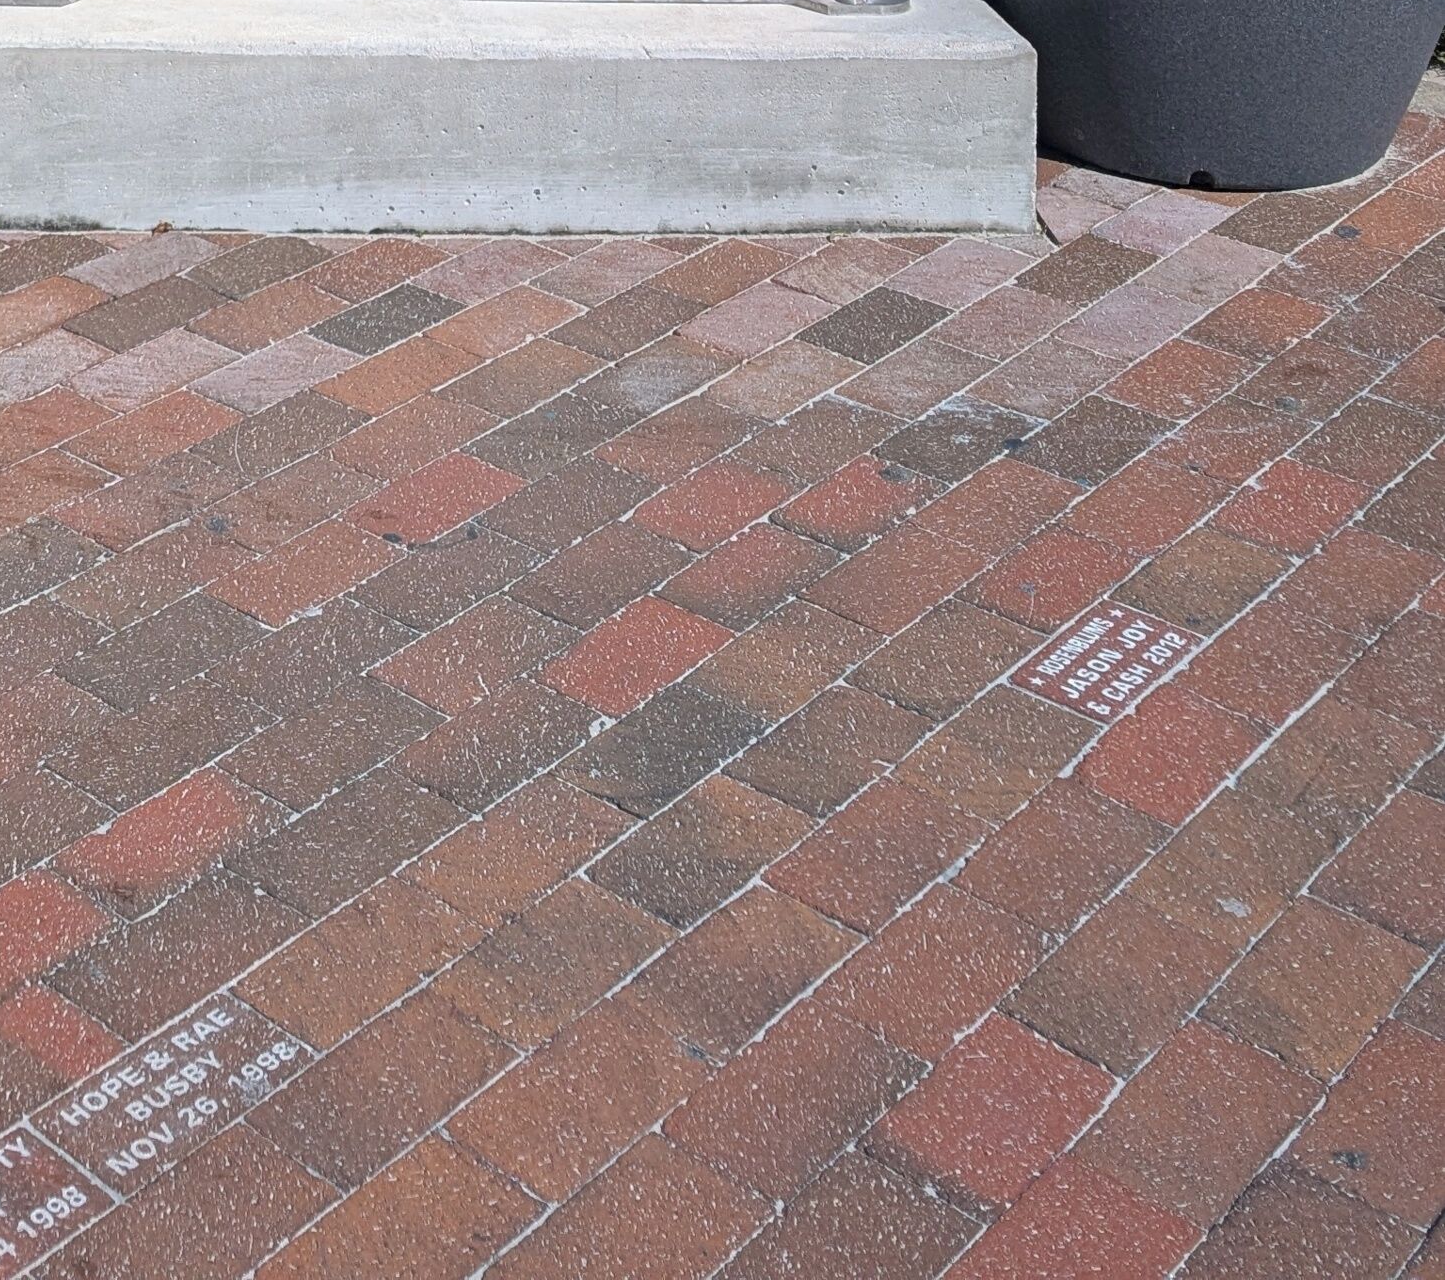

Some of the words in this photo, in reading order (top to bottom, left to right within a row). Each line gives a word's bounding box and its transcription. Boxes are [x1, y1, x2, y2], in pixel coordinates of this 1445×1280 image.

[1036, 617, 1115, 676] ROSENBLUMS
[1060, 649, 1124, 699] JASON
[1117, 619, 1154, 649] JOY
[1087, 701, 1111, 715] &
[1102, 663, 1152, 702] CASH
[1143, 632, 1188, 666] 2012
[60, 1065, 146, 1126] HOPE
[144, 1051, 174, 1070] &
[171, 1008, 234, 1051] RAE
[125, 1050, 221, 1121] BUSBY
[106, 1122, 175, 1176] NOV
[228, 1042, 299, 1090] 1998
[17, 1185, 87, 1238] 1998
